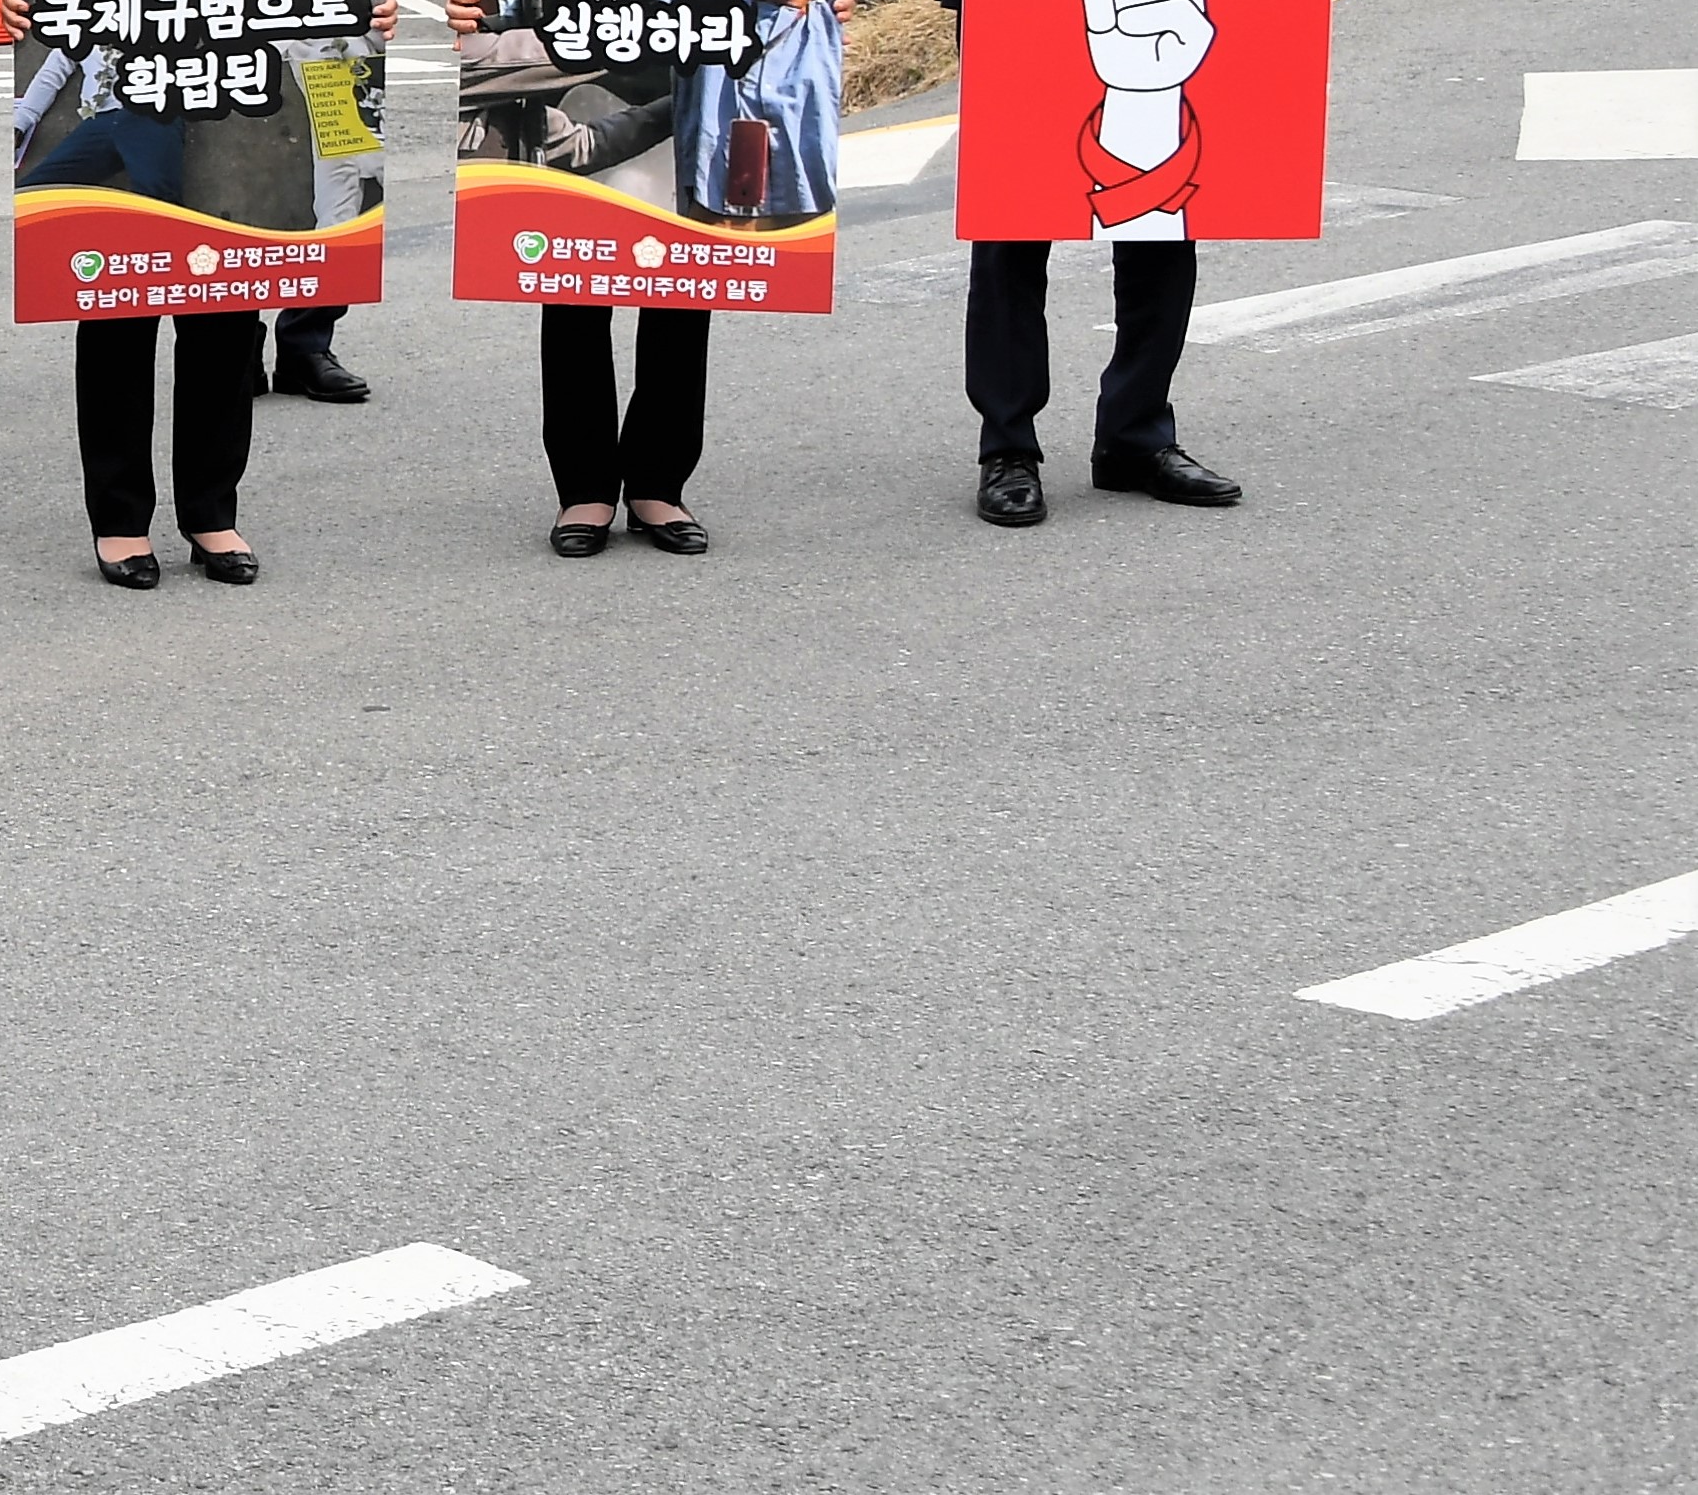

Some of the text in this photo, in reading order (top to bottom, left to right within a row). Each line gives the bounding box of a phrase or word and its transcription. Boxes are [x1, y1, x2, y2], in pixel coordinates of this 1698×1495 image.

[544, 2, 751, 64] 실행하라
[123, 49, 267, 112] 확립된
[311, 91, 334, 99] THEN
[315, 109, 343, 118] CRUEL
[322, 137, 364, 148] MILITARY
[109, 244, 325, 274] 함평군 함평군의회
[553, 238, 775, 266] 함평군 함평군의회
[77, 277, 318, 309] 동남아 결혼이주여성 일동
[519, 273, 767, 301] 동남아 결혼이주여성 일동
